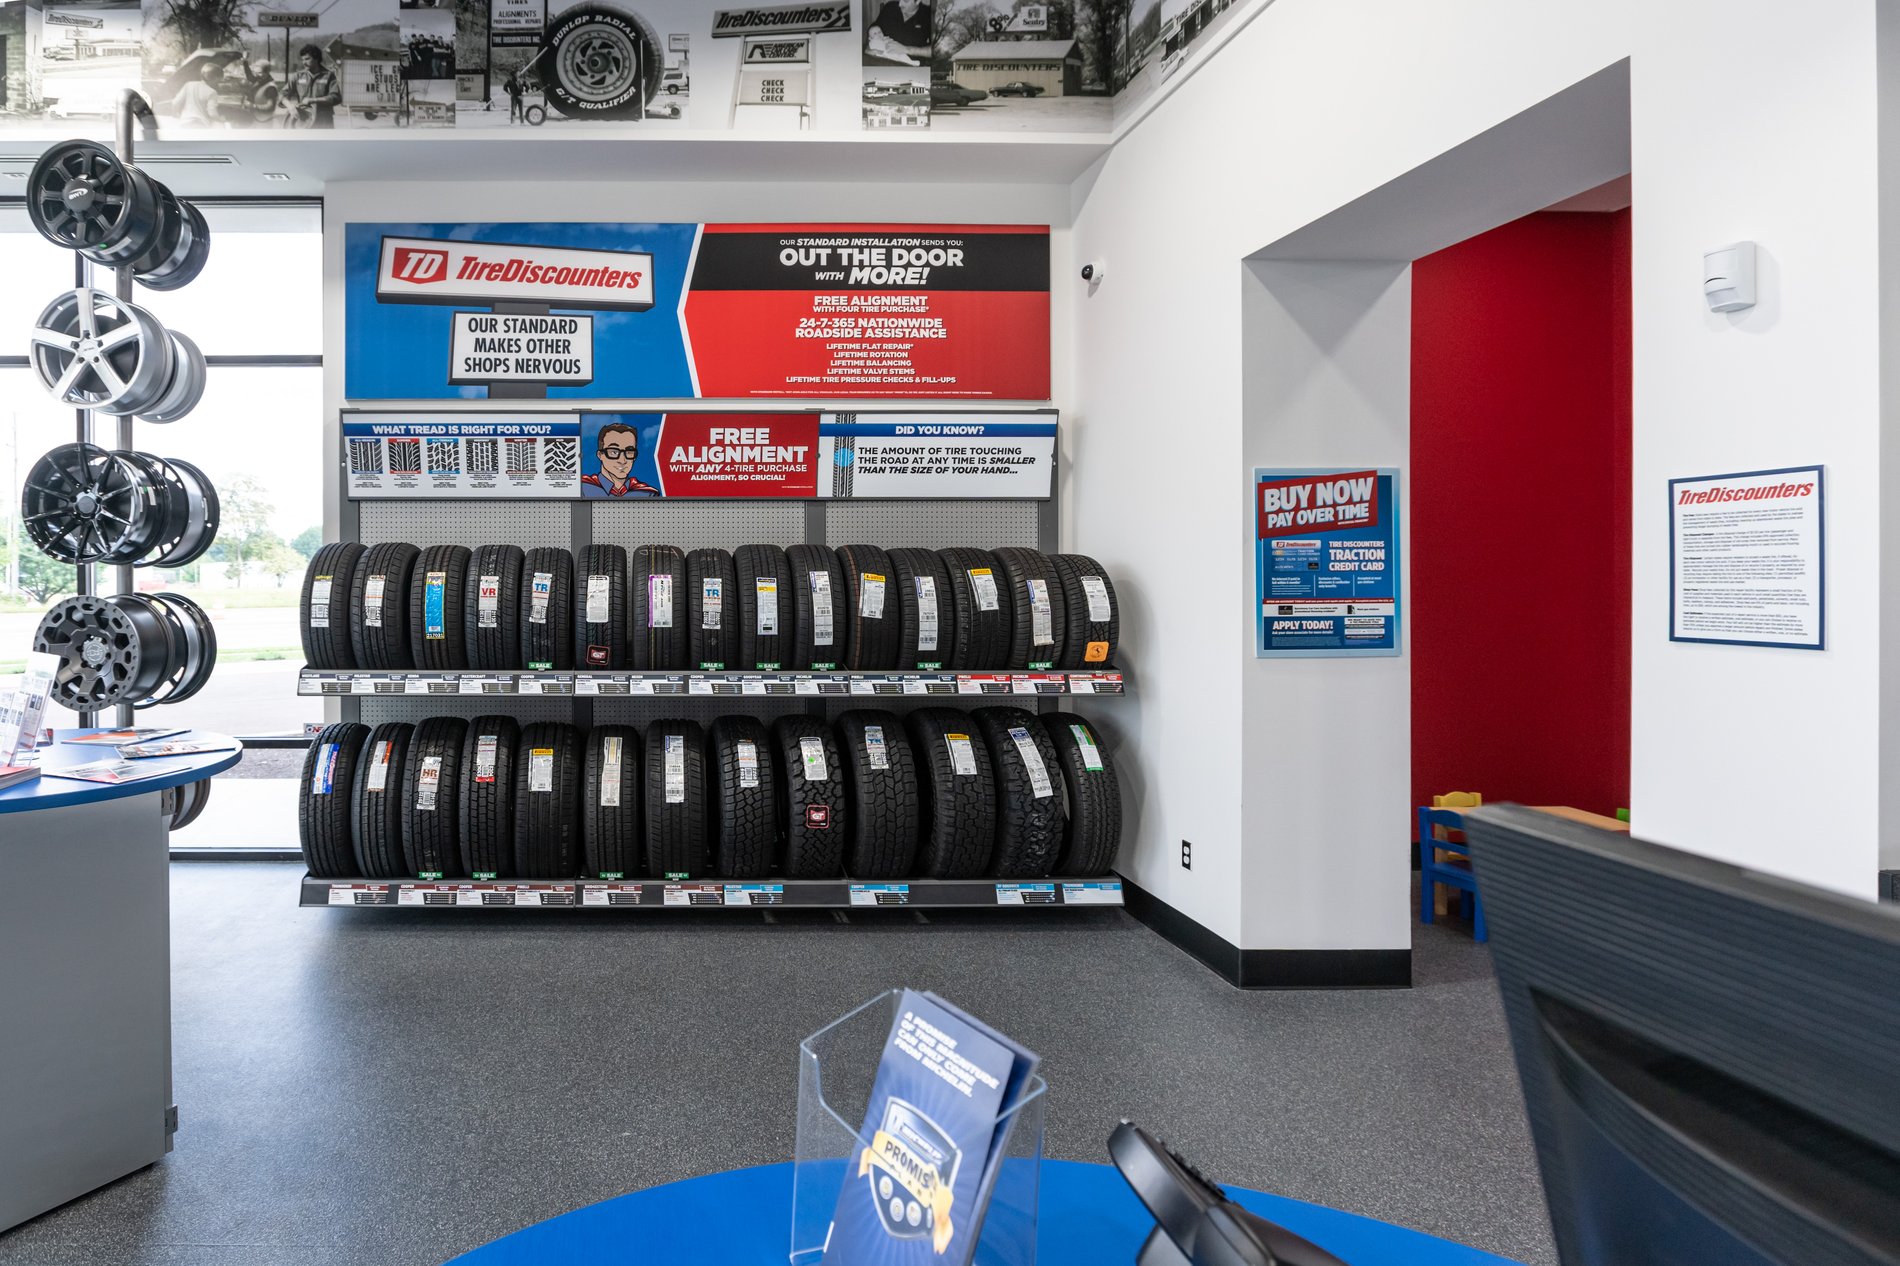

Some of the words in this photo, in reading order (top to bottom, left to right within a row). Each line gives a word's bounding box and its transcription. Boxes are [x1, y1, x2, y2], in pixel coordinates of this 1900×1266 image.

[498, 10, 537, 18] ALIGNMENTS
[716, 7, 835, 29] TireDiscounters
[1022, 18, 1045, 26] Sentry
[552, 15, 590, 46] DUNLOP
[594, 14, 637, 40] RADIAL
[956, 63, 978, 72] TIRE
[982, 63, 1062, 72] DISCOUNTERS
[374, 74, 398, 83] STUDS
[579, 86, 637, 110] QUALIFIER
[850, 238, 921, 246] INSTALLATION
[779, 247, 832, 266] OUT
[836, 247, 886, 266] THE
[892, 247, 964, 267] DOOR
[401, 252, 444, 278] TD
[456, 256, 643, 290] TireDiscounters
[815, 271, 845, 280] WITH
[848, 266, 931, 285] MORE!
[814, 295, 848, 306] FREE
[850, 295, 928, 306] ALIGNMENT
[468, 317, 498, 333] OUR
[503, 318, 578, 334] STANDARD
[796, 318, 856, 328] 24-7-365
[858, 318, 943, 328] NATIONWIDE
[795, 327, 862, 338] ROADSIDE
[864, 327, 947, 338] ASSISTANCE
[474, 337, 522, 354] MAKES
[526, 338, 571, 354] OTHER
[464, 357, 510, 373] SHOPS
[515, 358, 581, 374] NERVOUS
[372, 425, 407, 434] WHAT
[408, 425, 446, 434] TREAD
[448, 425, 459, 434] IS
[461, 425, 495, 434] RIGHT
[497, 425, 520, 434] FOR
[521, 425, 552, 434] YOU?
[710, 427, 770, 445] FREE
[895, 425, 915, 435] DID
[917, 425, 941, 435] YOU
[943, 425, 985, 435] KNOW?
[670, 445, 809, 463] ALIGNMENT
[858, 456, 878, 464] THE
[880, 456, 909, 465] ROAD
[911, 456, 925, 465] AT
[927, 457, 949, 465] ANY
[951, 457, 975, 465] TIME
[977, 457, 987, 465] IS
[989, 457, 1036, 465] SMALLER
[695, 464, 724, 473] ANY
[1264, 484, 1312, 512] BUY
[1316, 477, 1374, 507] NOW
[1678, 482, 1814, 506] TireDiscounters
[1268, 512, 1294, 528] PAY
[1296, 506, 1334, 526] OVER
[1336, 502, 1370, 520] TIME
[1329, 549, 1385, 561] TRACTION
[1329, 562, 1360, 571] CREDIT
[1360, 561, 1385, 571] CARD
[535, 583, 548, 592] TR
[706, 589, 720, 597] TR
[1272, 620, 1300, 630] APPLY
[1301, 620, 1334, 630] TODAY!
[423, 768, 438, 778] HR
[904, 1011, 914, 1022] A
[913, 1016, 958, 1052] PROMISE
[898, 1028, 919, 1047] CAN
[918, 1042, 946, 1064] ONLY
[944, 1060, 977, 1086] COME
[901, 1018, 916, 1032] OF
[914, 1028, 938, 1048] THIS
[936, 1042, 1000, 1090] MAGNITUDE
[894, 1037, 923, 1062] FROM
[921, 1056, 974, 1098] MICHELIN.
